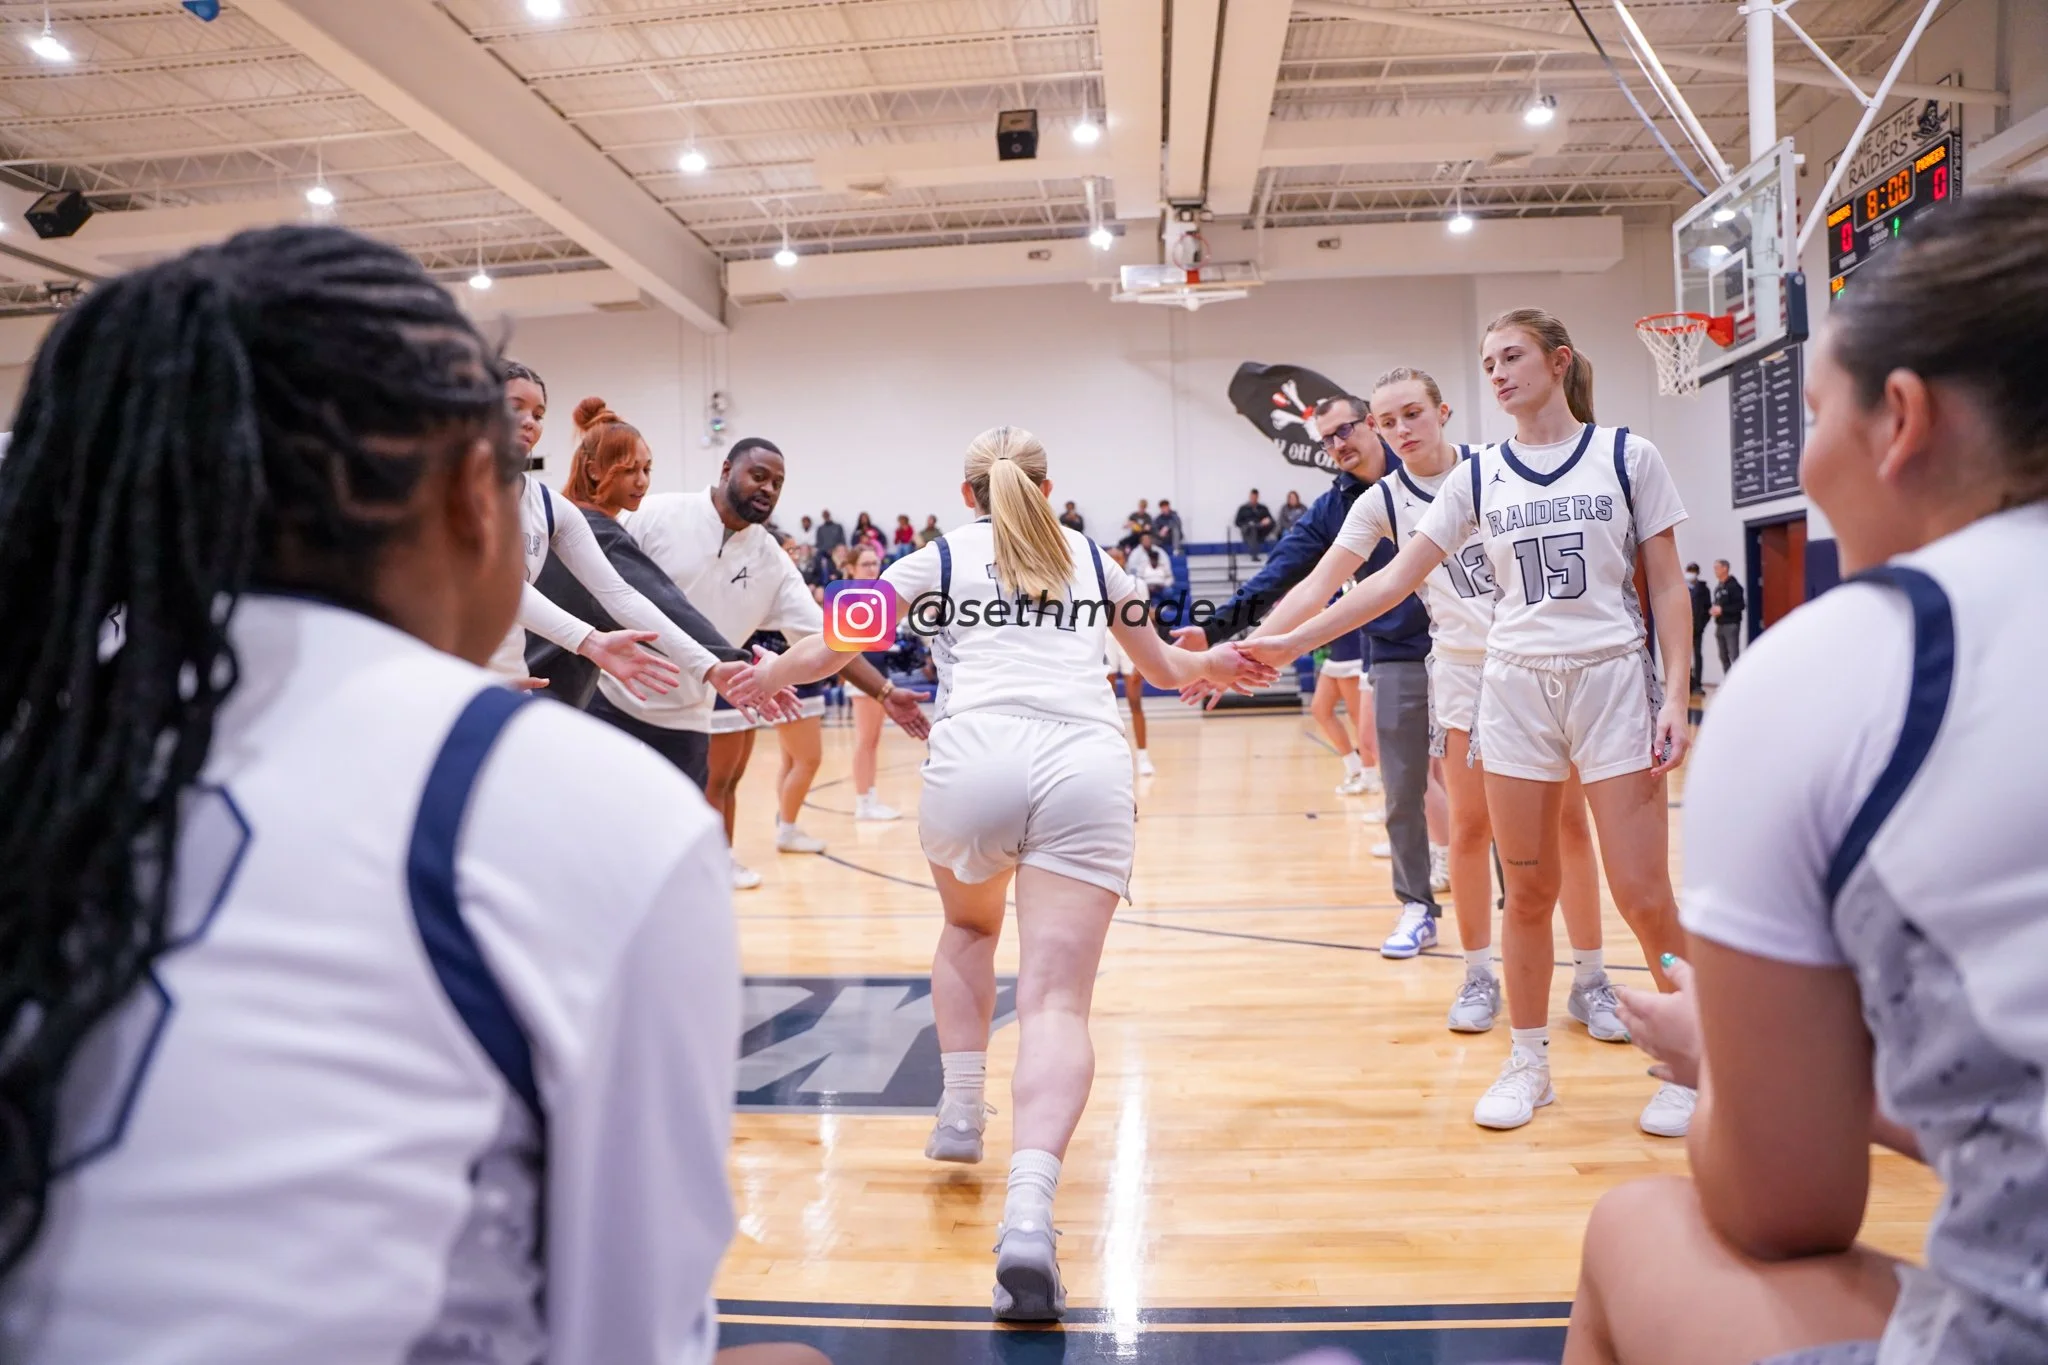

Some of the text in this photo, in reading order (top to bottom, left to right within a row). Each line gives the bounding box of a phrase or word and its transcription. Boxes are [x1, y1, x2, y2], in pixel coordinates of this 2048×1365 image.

[1876, 124, 1890, 148] OF
[1893, 106, 1915, 134] THE
[1849, 132, 1909, 188] RAIDERS
[1933, 165, 1948, 201] 0
[1866, 169, 1910, 220] 8:00
[1841, 221, 1853, 253] 0
[1485, 494, 1613, 538] RAIDERS
[1441, 542, 1495, 599] 12
[1512, 531, 1588, 606] 15
